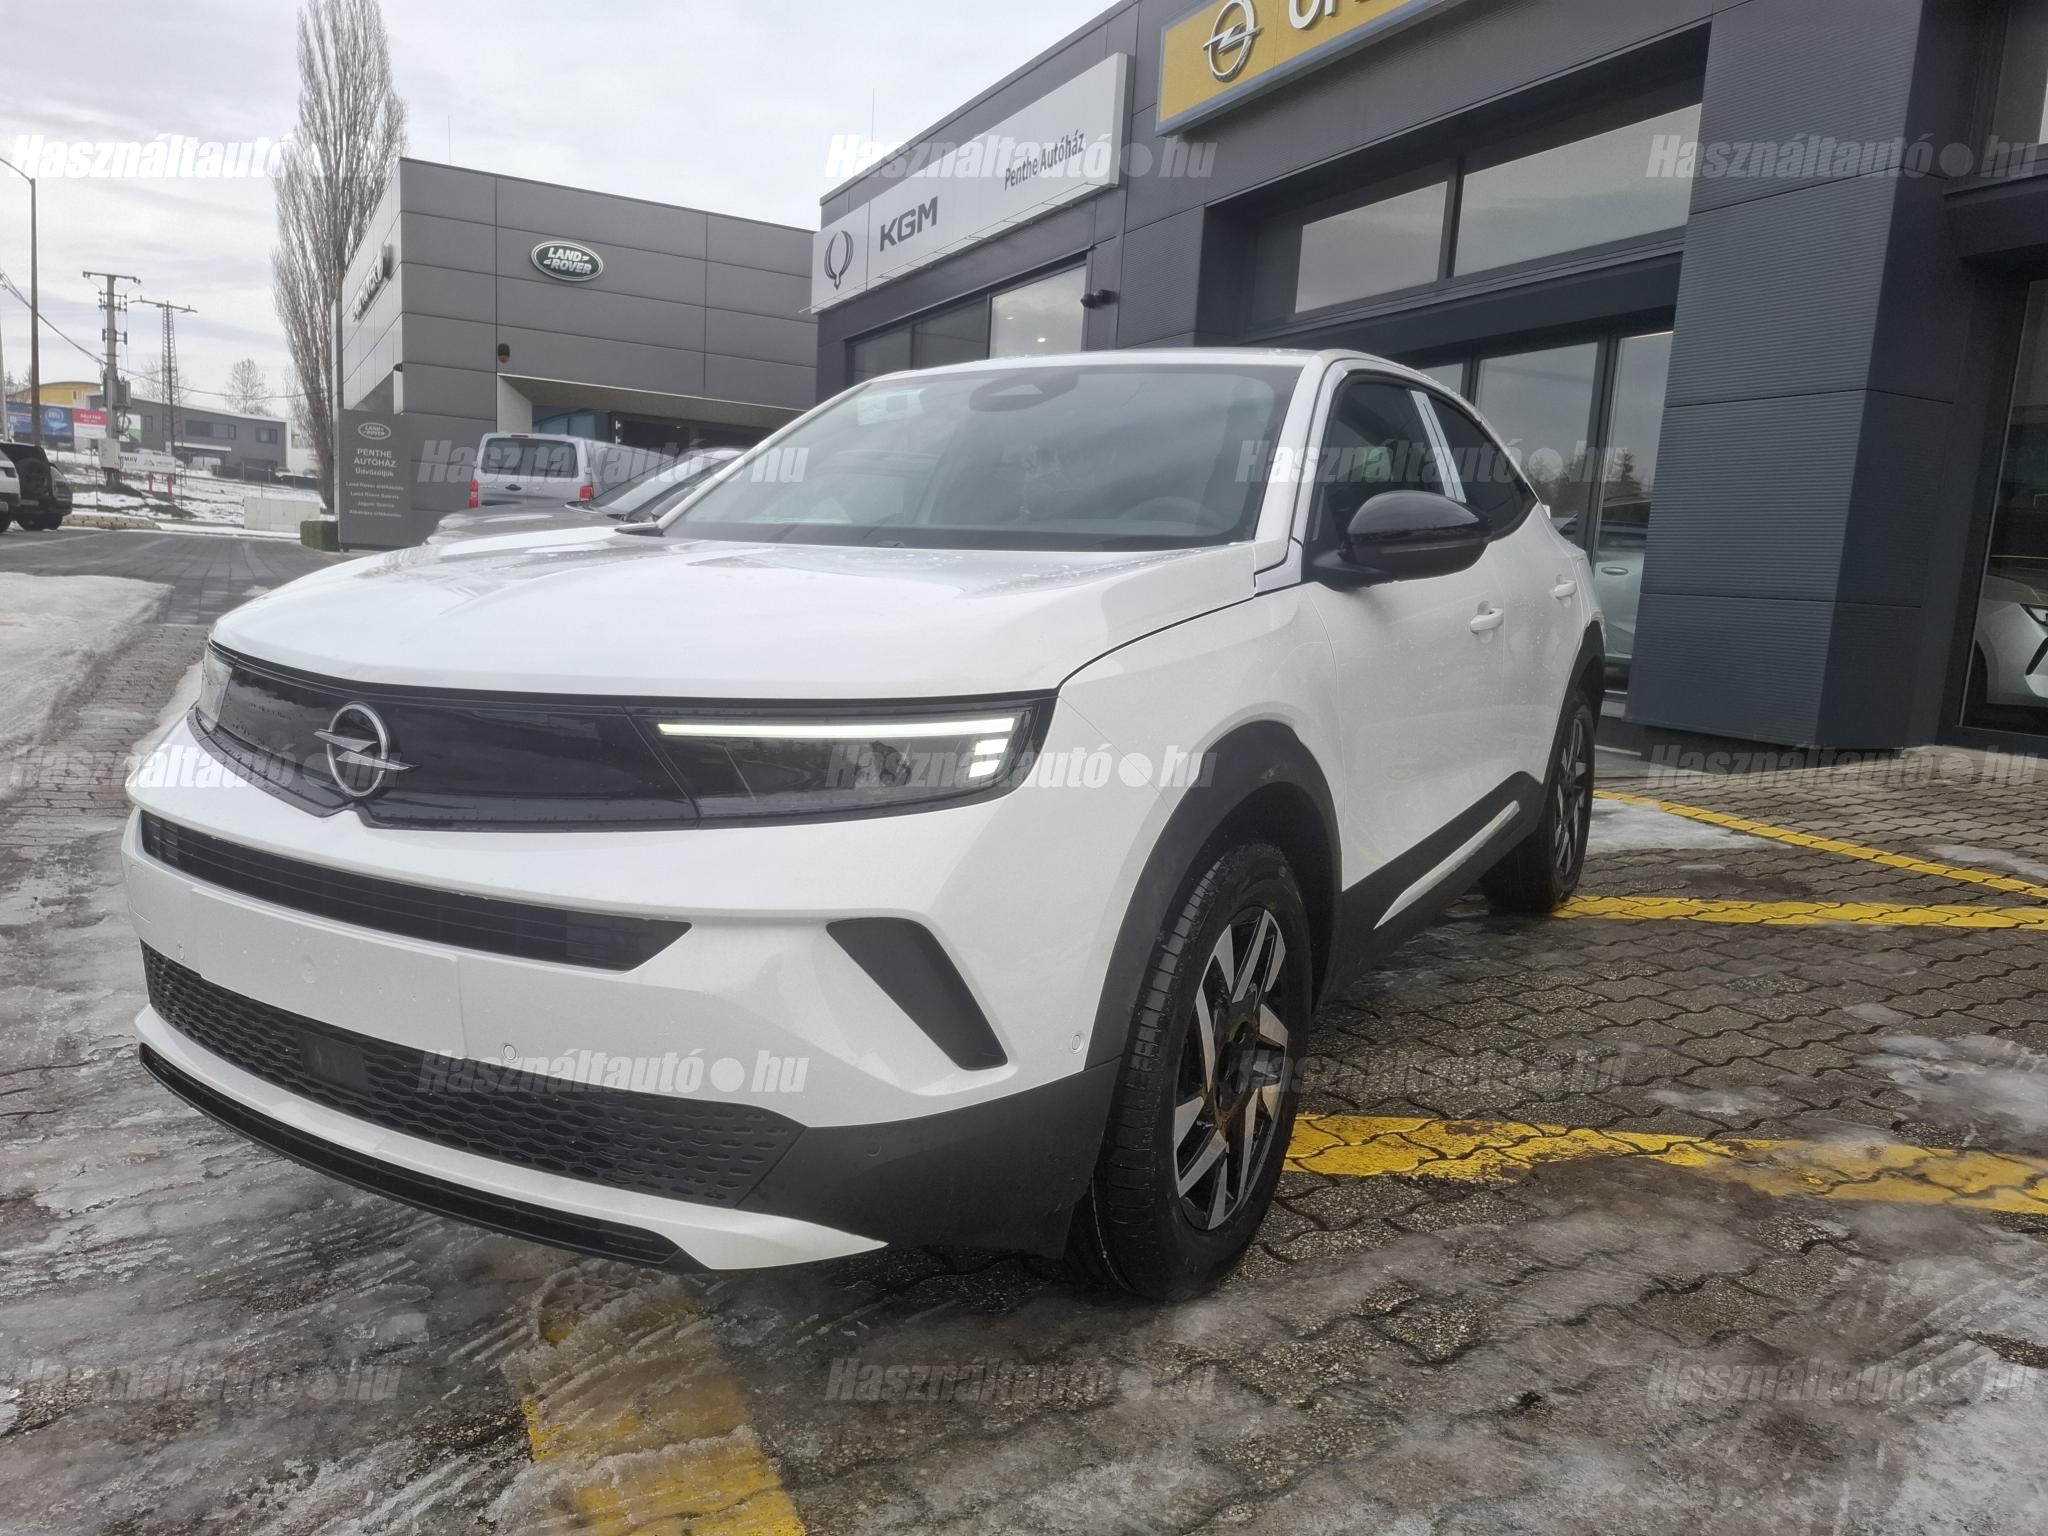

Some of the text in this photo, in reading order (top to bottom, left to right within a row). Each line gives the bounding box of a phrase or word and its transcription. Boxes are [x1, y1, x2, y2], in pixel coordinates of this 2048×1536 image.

[1004, 129, 1084, 191] Penthe Autóház
[880, 195, 938, 252] KGM
[547, 247, 582, 262] LAND
[550, 258, 592, 274] ROVER
[357, 448, 392, 458] PENTHE
